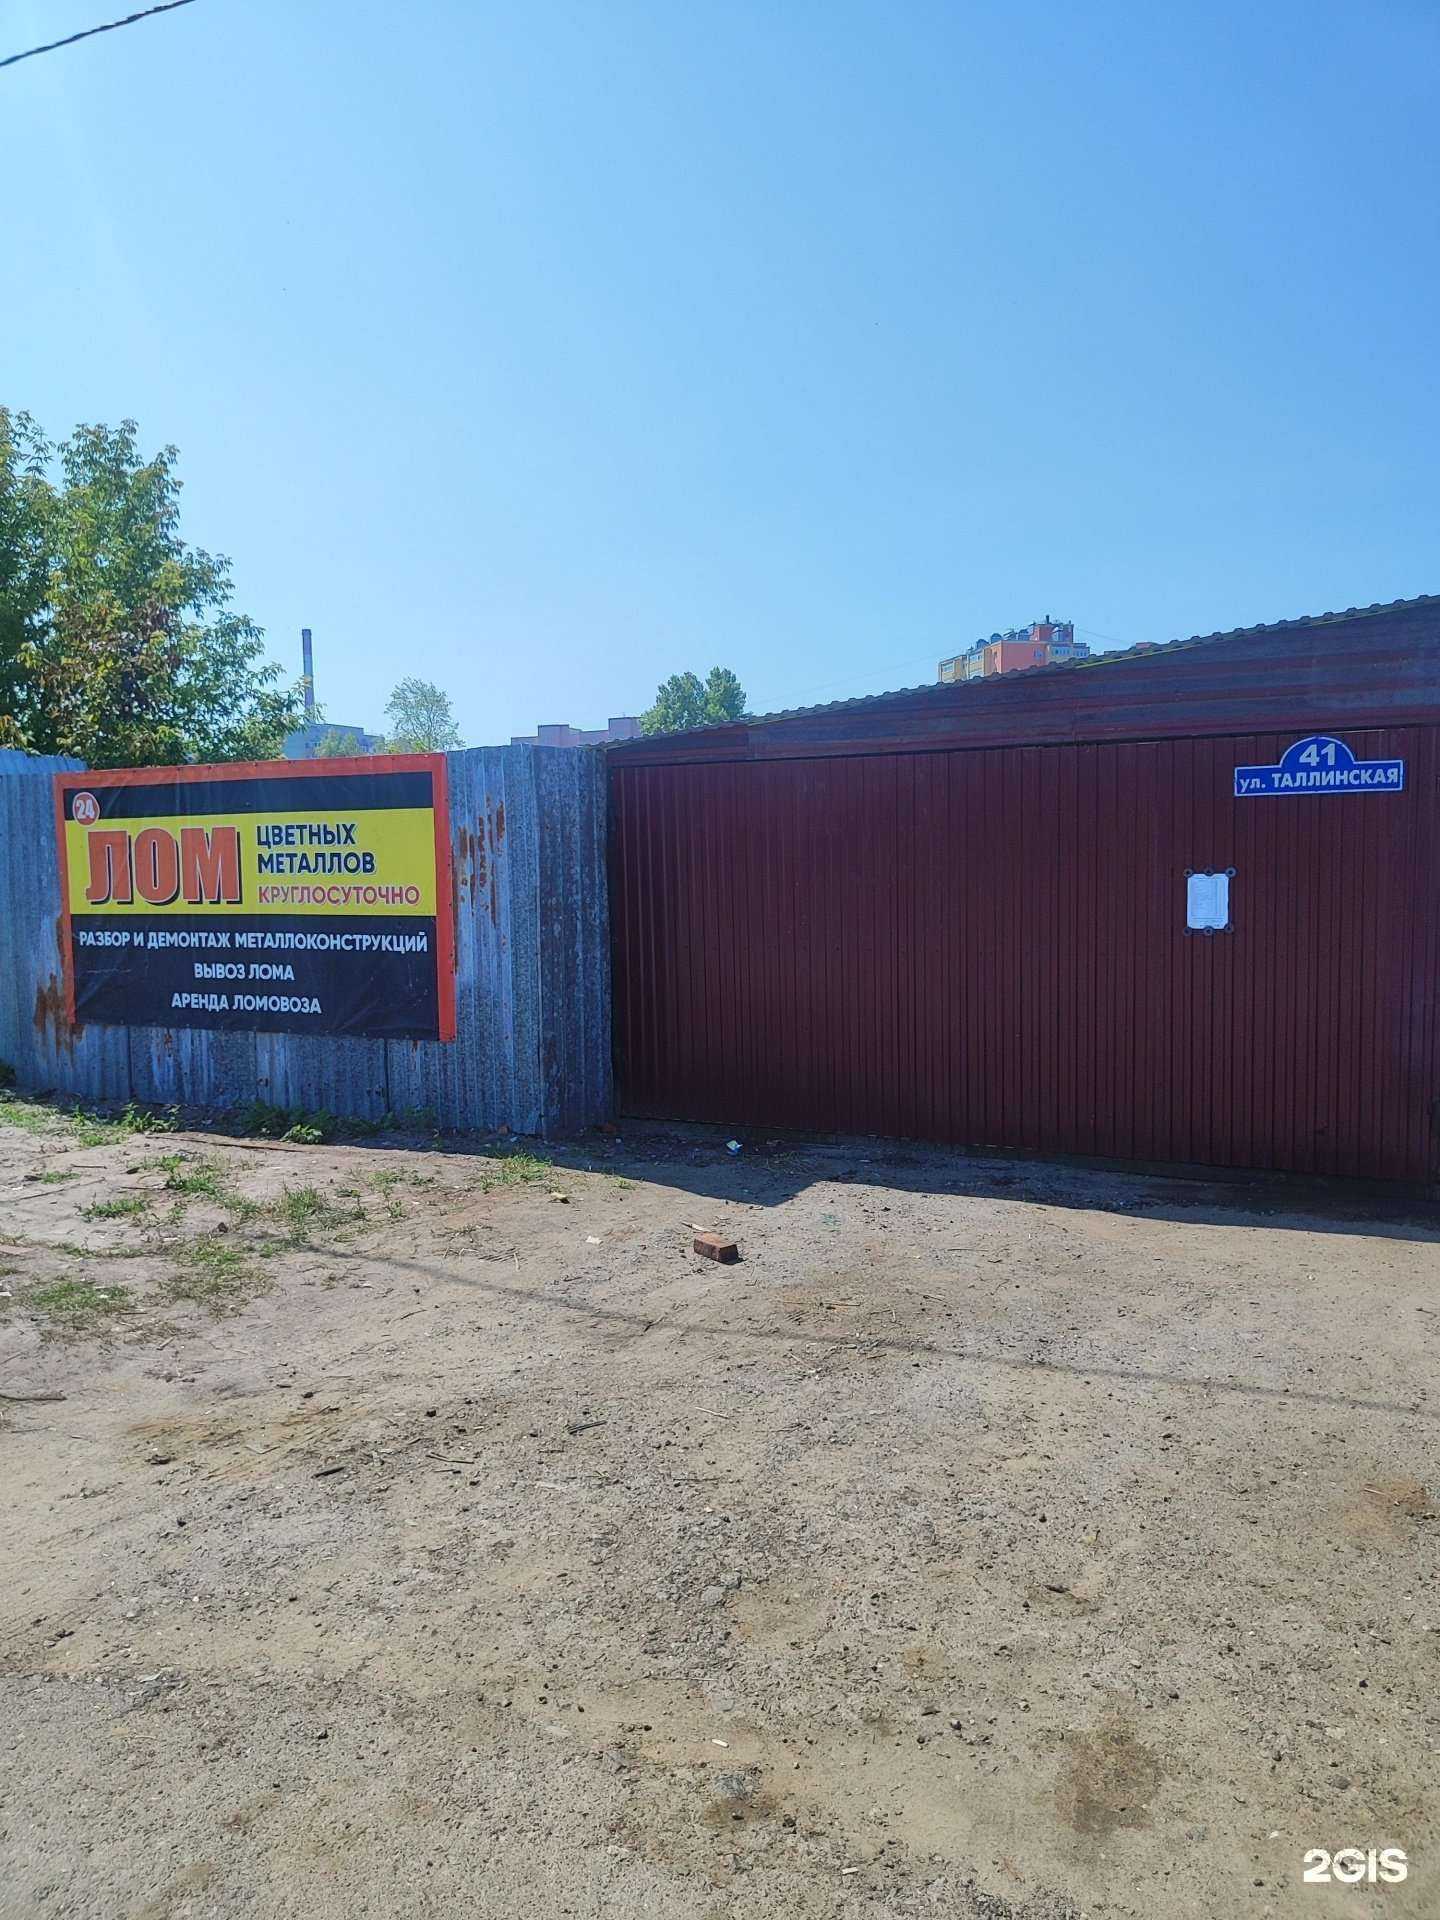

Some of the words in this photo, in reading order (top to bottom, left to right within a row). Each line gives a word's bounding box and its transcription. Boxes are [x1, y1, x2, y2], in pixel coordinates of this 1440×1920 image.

[1299, 743, 1336, 766] 41
[1239, 777, 1266, 793] ул.
[1271, 768, 1398, 788] ТАЛЛИНСКАЯ
[76, 799, 95, 819] 24
[256, 823, 356, 850] ЦВЕТНЫХ
[85, 826, 241, 905] ЛОМ
[257, 852, 376, 875] МЕТАЛЛОВ
[258, 884, 420, 906] КРУГЛОСУТОЧНО
[79, 931, 131, 948] РАЗБОР
[133, 931, 145, 948] И
[147, 931, 231, 950] ДЕМОНТАЖ
[235, 931, 428, 954] МЕТАЛЛОКОНСТРУКЦИЙ
[193, 963, 245, 980] ВЫВОЗ
[248, 964, 295, 981] ЛОМА
[171, 993, 229, 1013] АРЕНДА
[232, 994, 322, 1015] ЛОМОВОЗА
